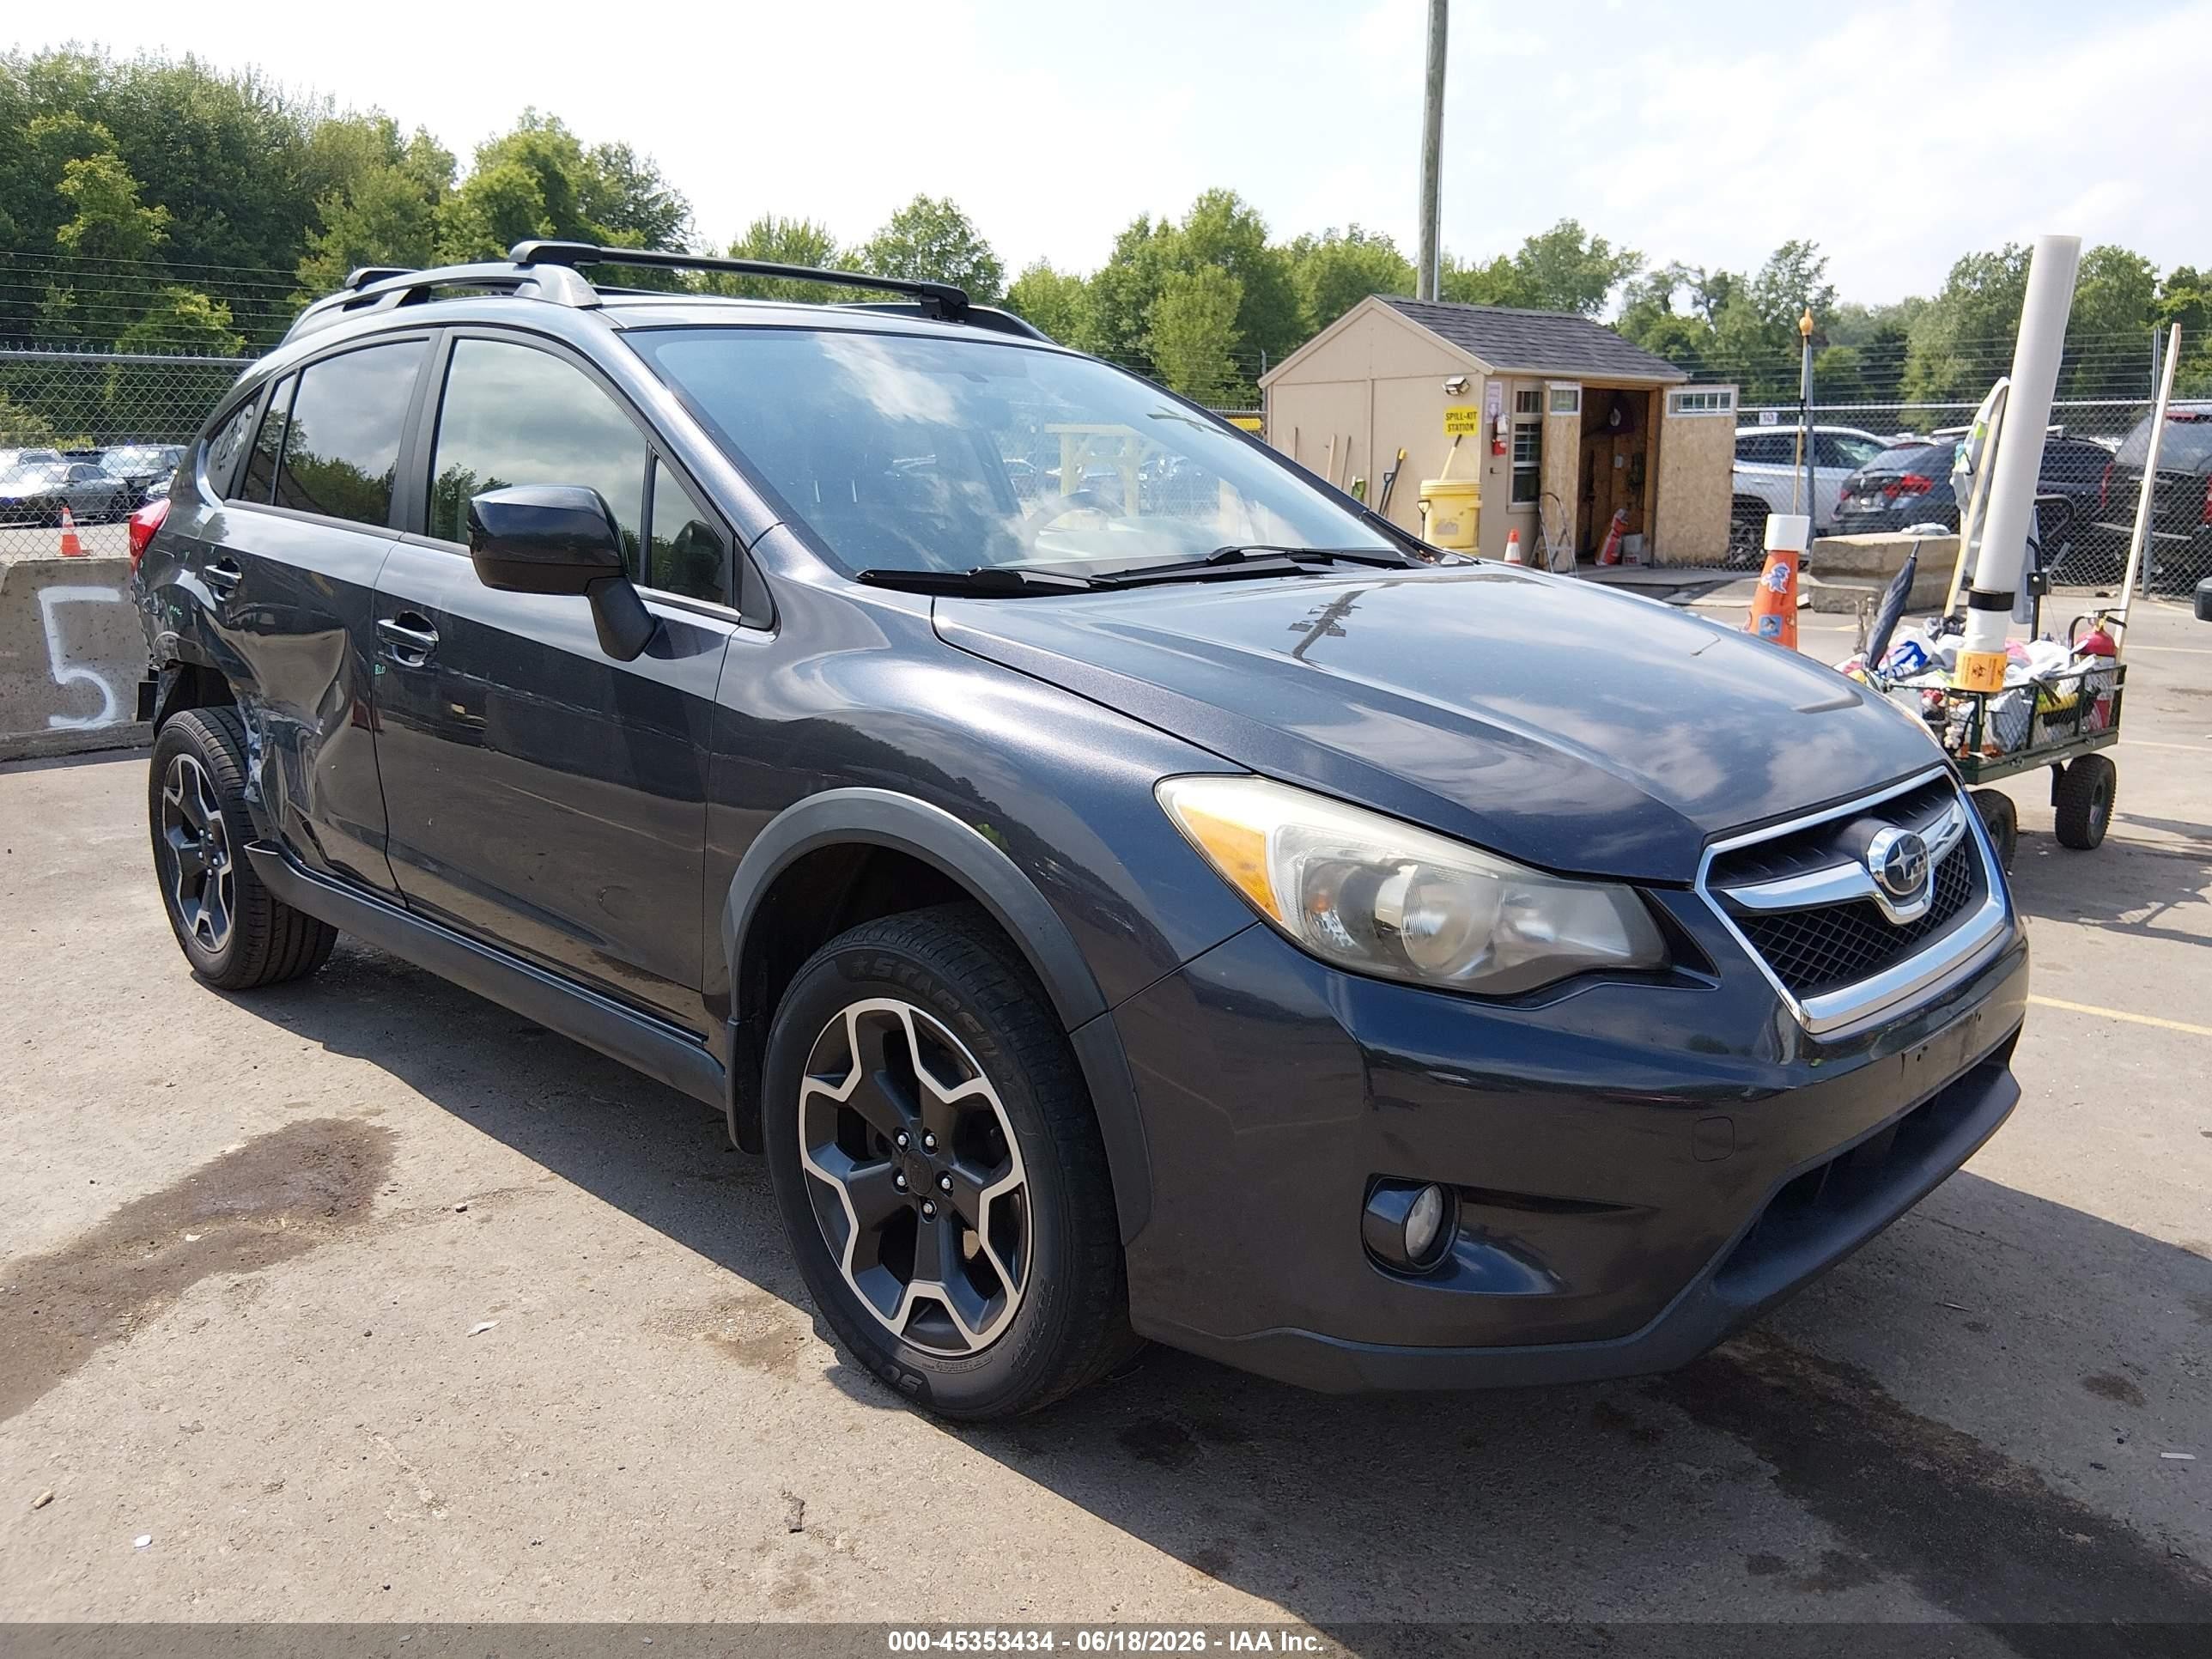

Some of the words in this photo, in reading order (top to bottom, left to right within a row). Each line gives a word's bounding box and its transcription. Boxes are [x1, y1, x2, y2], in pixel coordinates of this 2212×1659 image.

[1445, 412, 1477, 421] SPILL-KIT
[1448, 423, 1474, 432] STATION
[38, 586, 120, 730] 5
